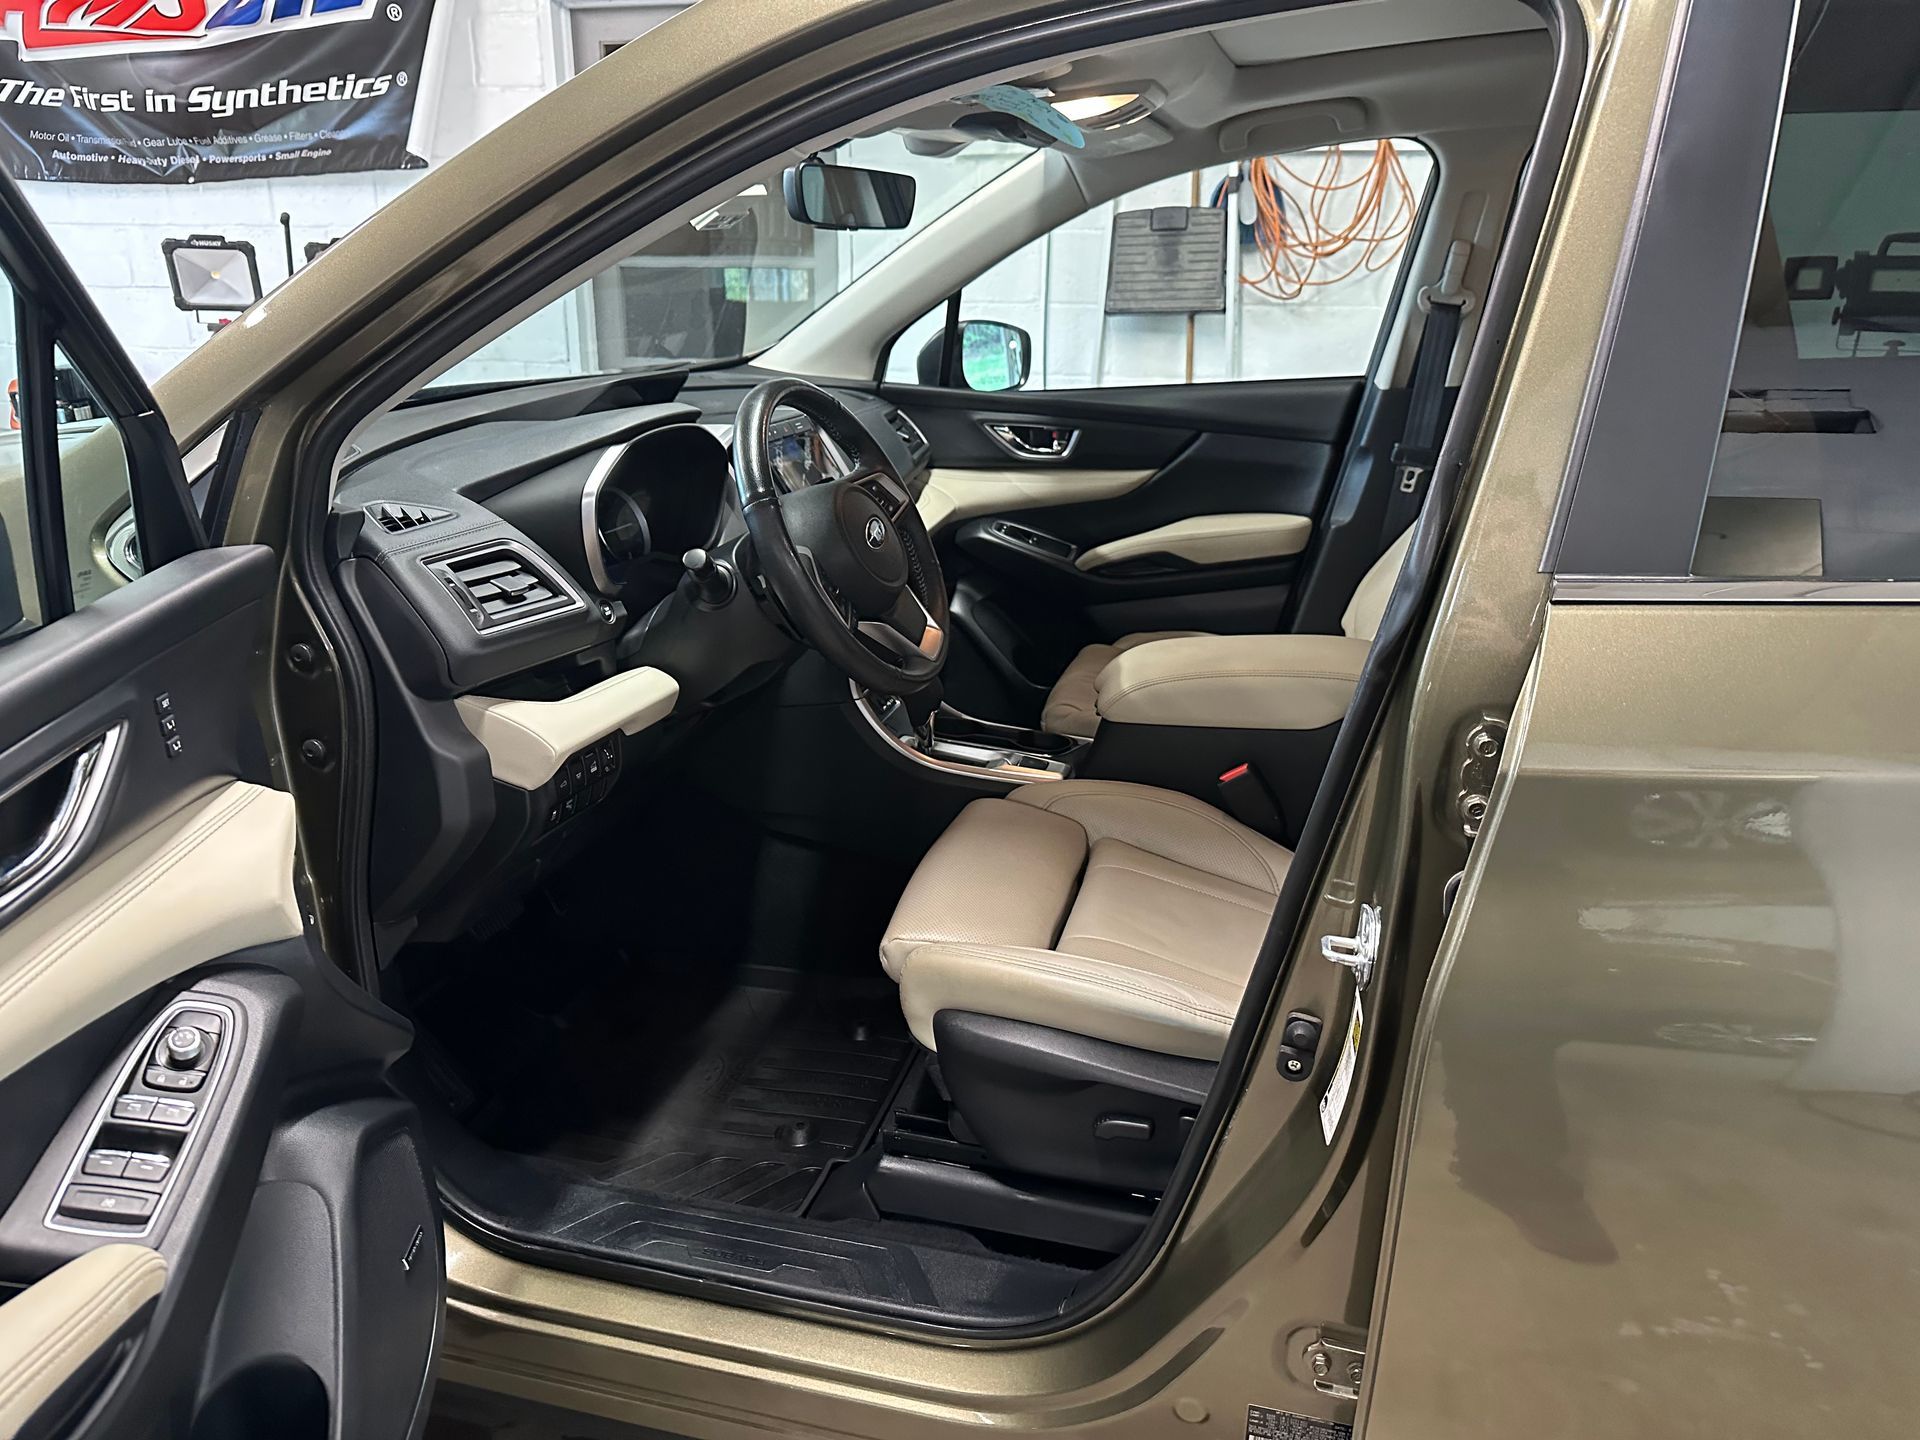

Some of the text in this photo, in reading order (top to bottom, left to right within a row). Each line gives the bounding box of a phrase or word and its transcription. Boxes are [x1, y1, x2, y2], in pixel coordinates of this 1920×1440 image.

[0, 73, 392, 118] The First in Synthetics
[30, 130, 56, 141] Motor
[57, 132, 70, 143] Oil
[143, 137, 165, 148] Gear
[212, 135, 248, 145] Additives
[254, 132, 283, 143] Grease
[52, 149, 109, 163] Automotive
[208, 154, 267, 164] Powersports
[275, 150, 300, 160] Small
[301, 148, 332, 159] Engine
